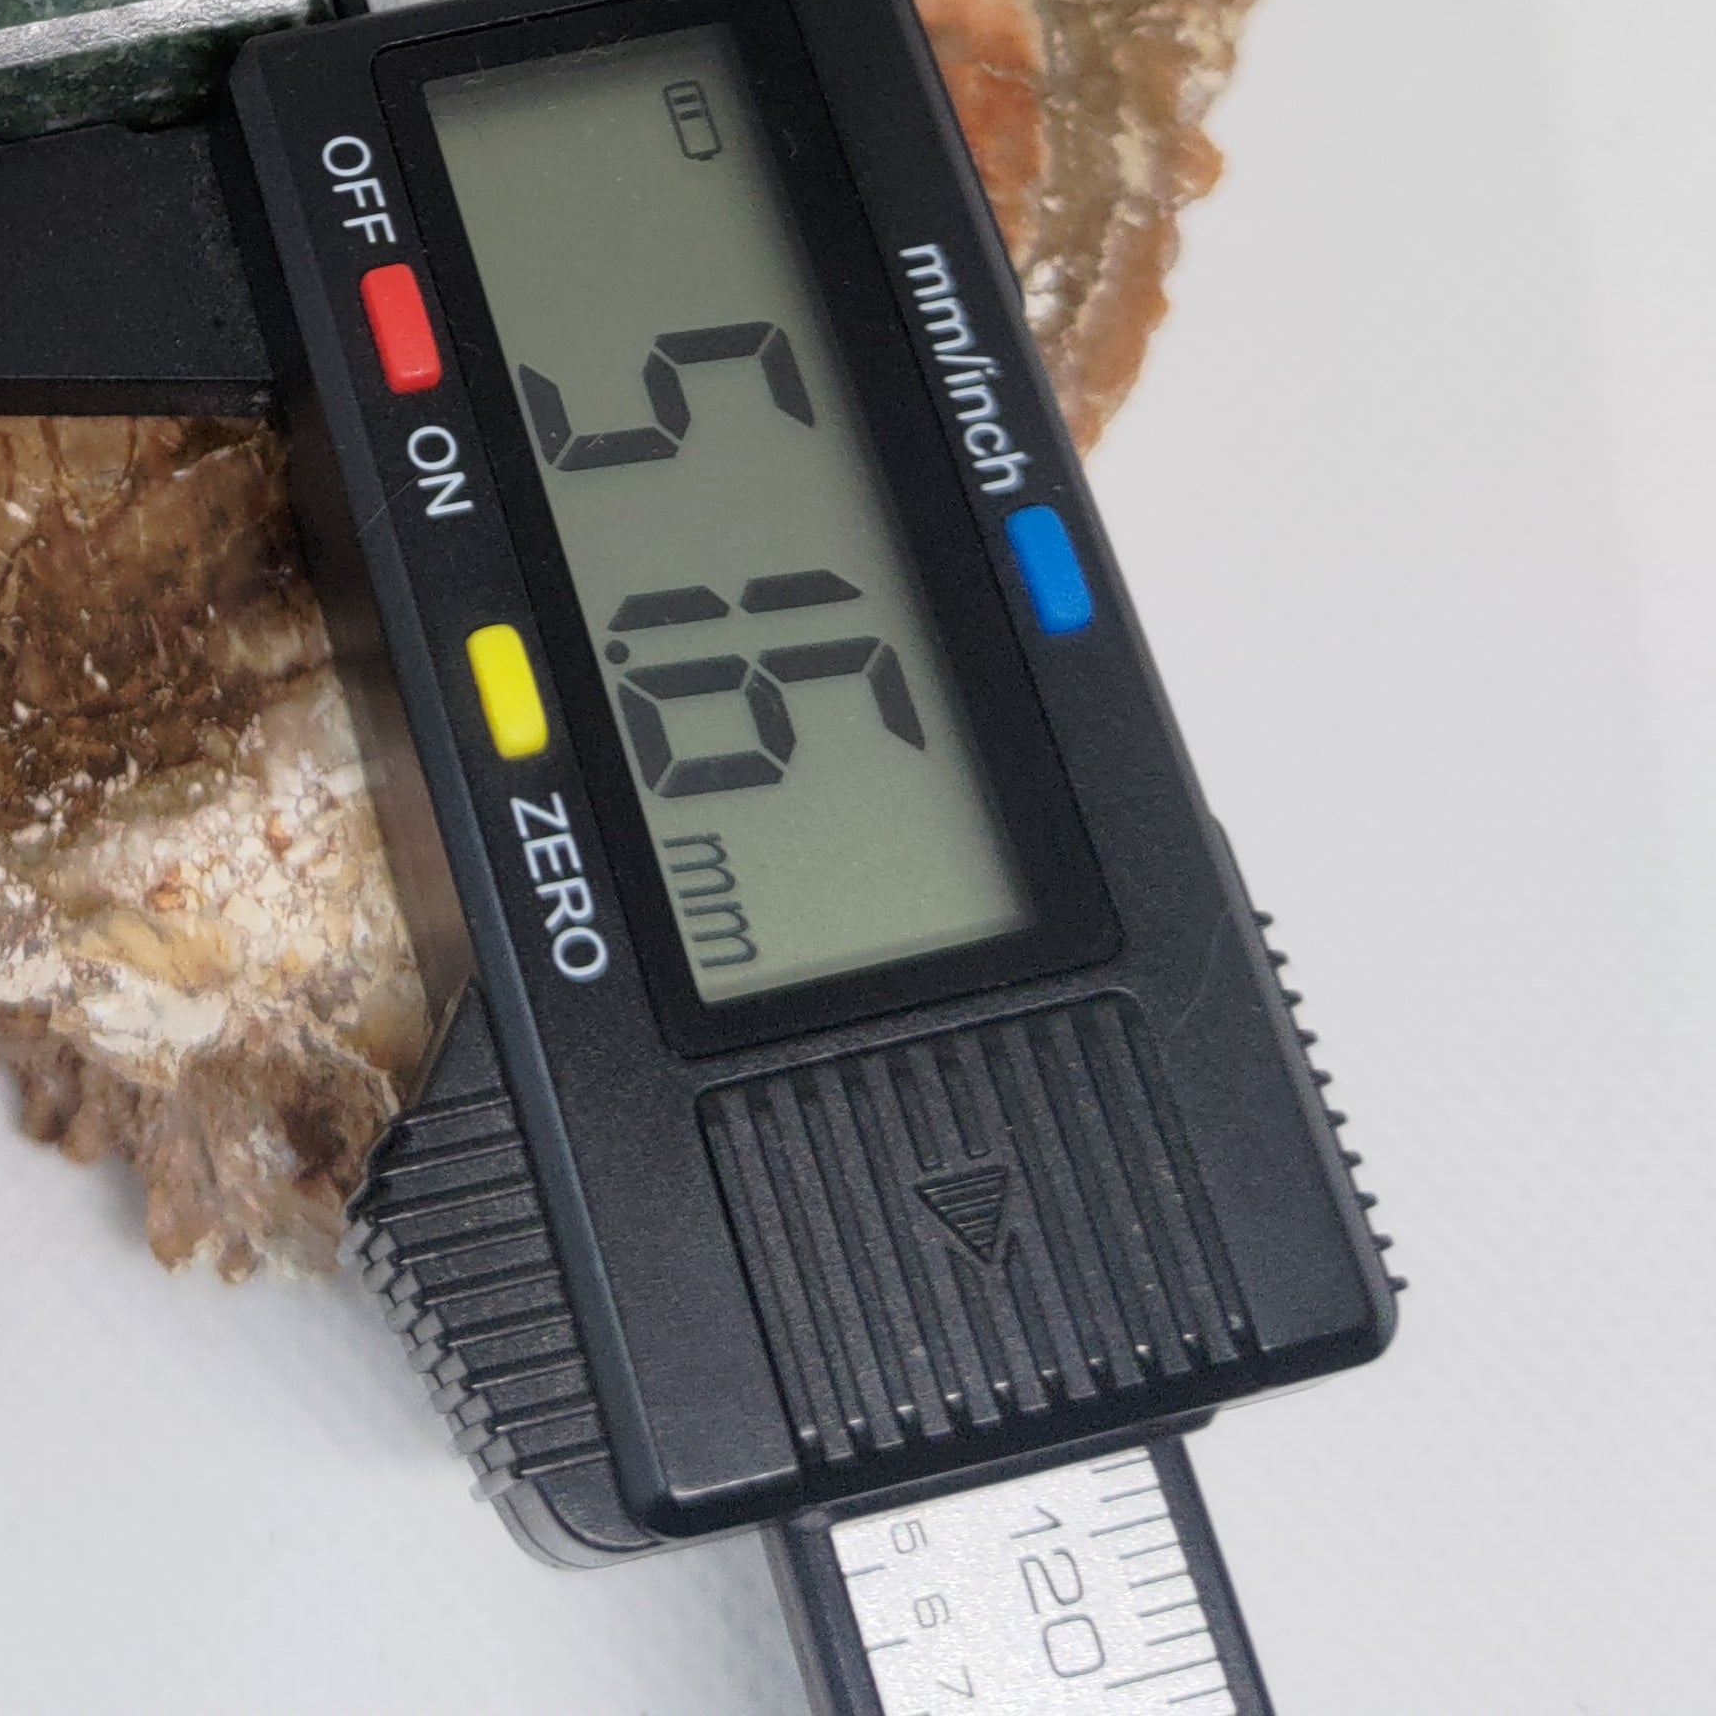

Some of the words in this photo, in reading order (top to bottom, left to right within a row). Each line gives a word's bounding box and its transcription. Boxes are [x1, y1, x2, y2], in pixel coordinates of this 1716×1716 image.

[322, 135, 397, 244] OFF
[897, 242, 1030, 494] mm/inch
[407, 425, 475, 517] ON
[517, 321, 926, 799] 51.6
[509, 791, 610, 982] ZERO
[660, 832, 759, 969] mm
[889, 1519, 929, 1555] 5
[913, 1593, 952, 1630] 6
[935, 1665, 976, 1699] 7
[1011, 1505, 1106, 1678] 120
